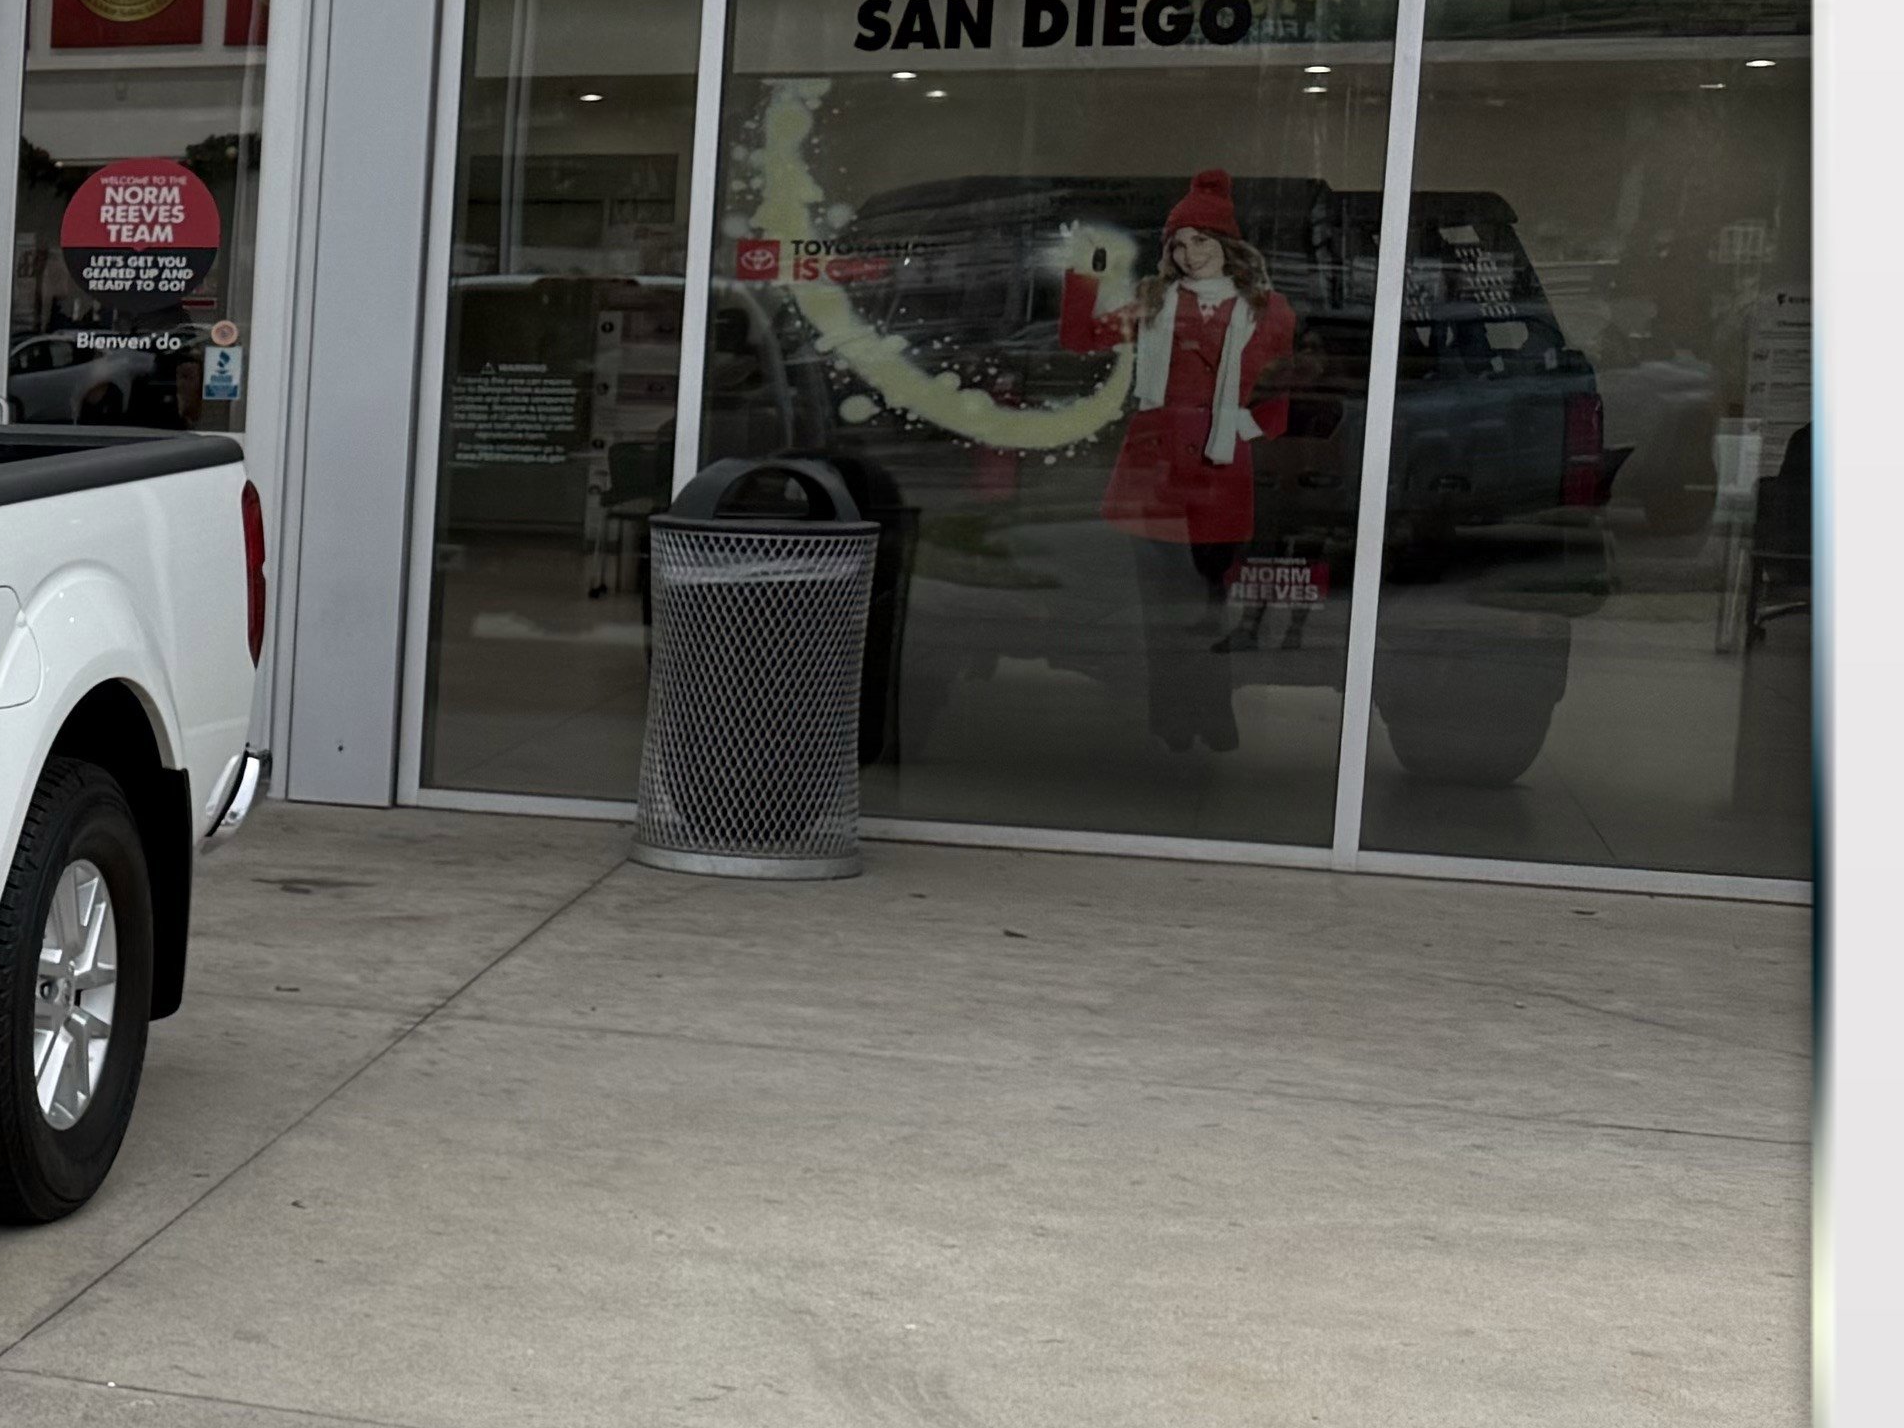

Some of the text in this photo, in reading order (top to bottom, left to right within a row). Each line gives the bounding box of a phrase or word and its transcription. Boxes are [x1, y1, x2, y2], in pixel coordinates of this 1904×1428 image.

[100, 176, 187, 185] WELCOME TO THE
[104, 186, 181, 204] NORM
[100, 205, 186, 223] REEVES
[106, 224, 174, 243] TEAM
[90, 255, 187, 268] LET'S GET YOU
[82, 267, 194, 280] GEARED UP AND
[88, 279, 186, 292] READY TO GO!
[76, 332, 181, 350] Bienvendo
[1240, 566, 1311, 584] NORM
[1231, 582, 1319, 601] REEVES
